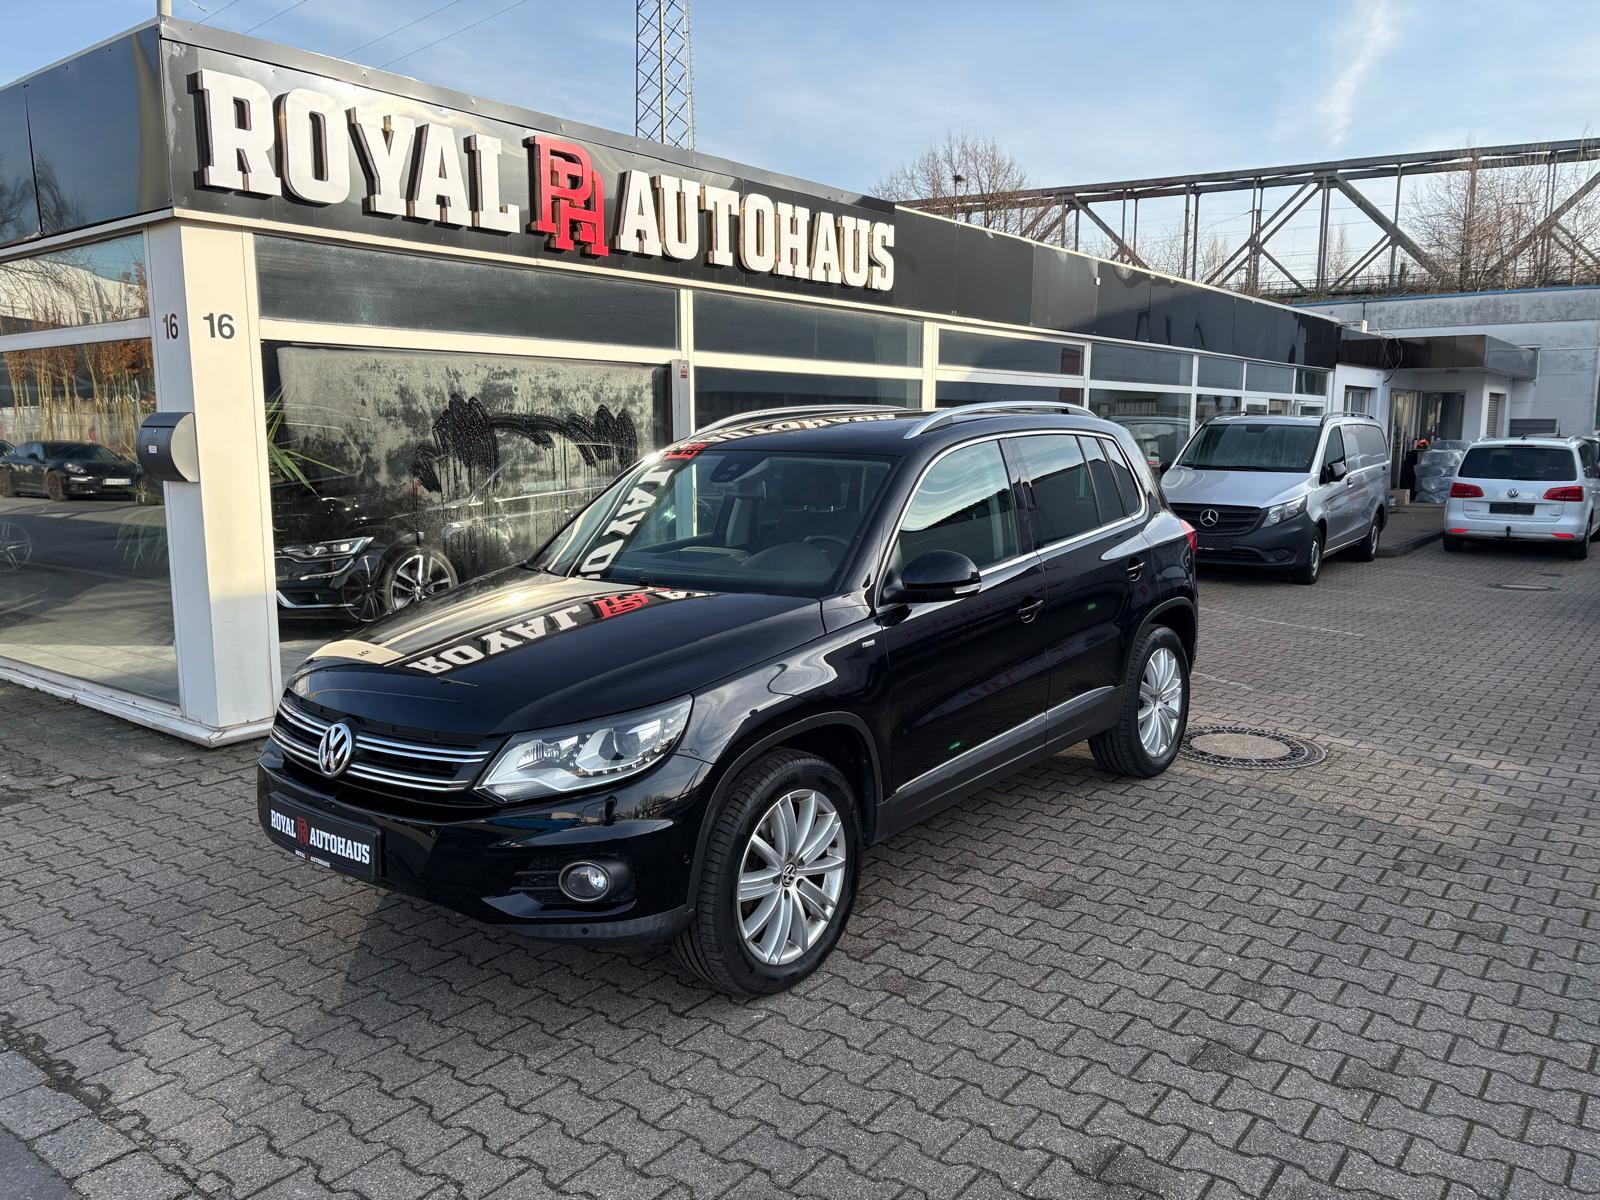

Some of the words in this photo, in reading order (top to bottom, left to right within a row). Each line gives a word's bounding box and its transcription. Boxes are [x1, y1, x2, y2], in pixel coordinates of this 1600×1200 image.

[190, 68, 520, 233] ROYAL
[613, 169, 895, 291] AUTOHAUS
[163, 313, 179, 340] 16
[203, 312, 235, 340] 16
[319, 722, 352, 778] VW
[271, 809, 297, 839] ROYAL
[309, 827, 370, 865] AUTOHAUS
